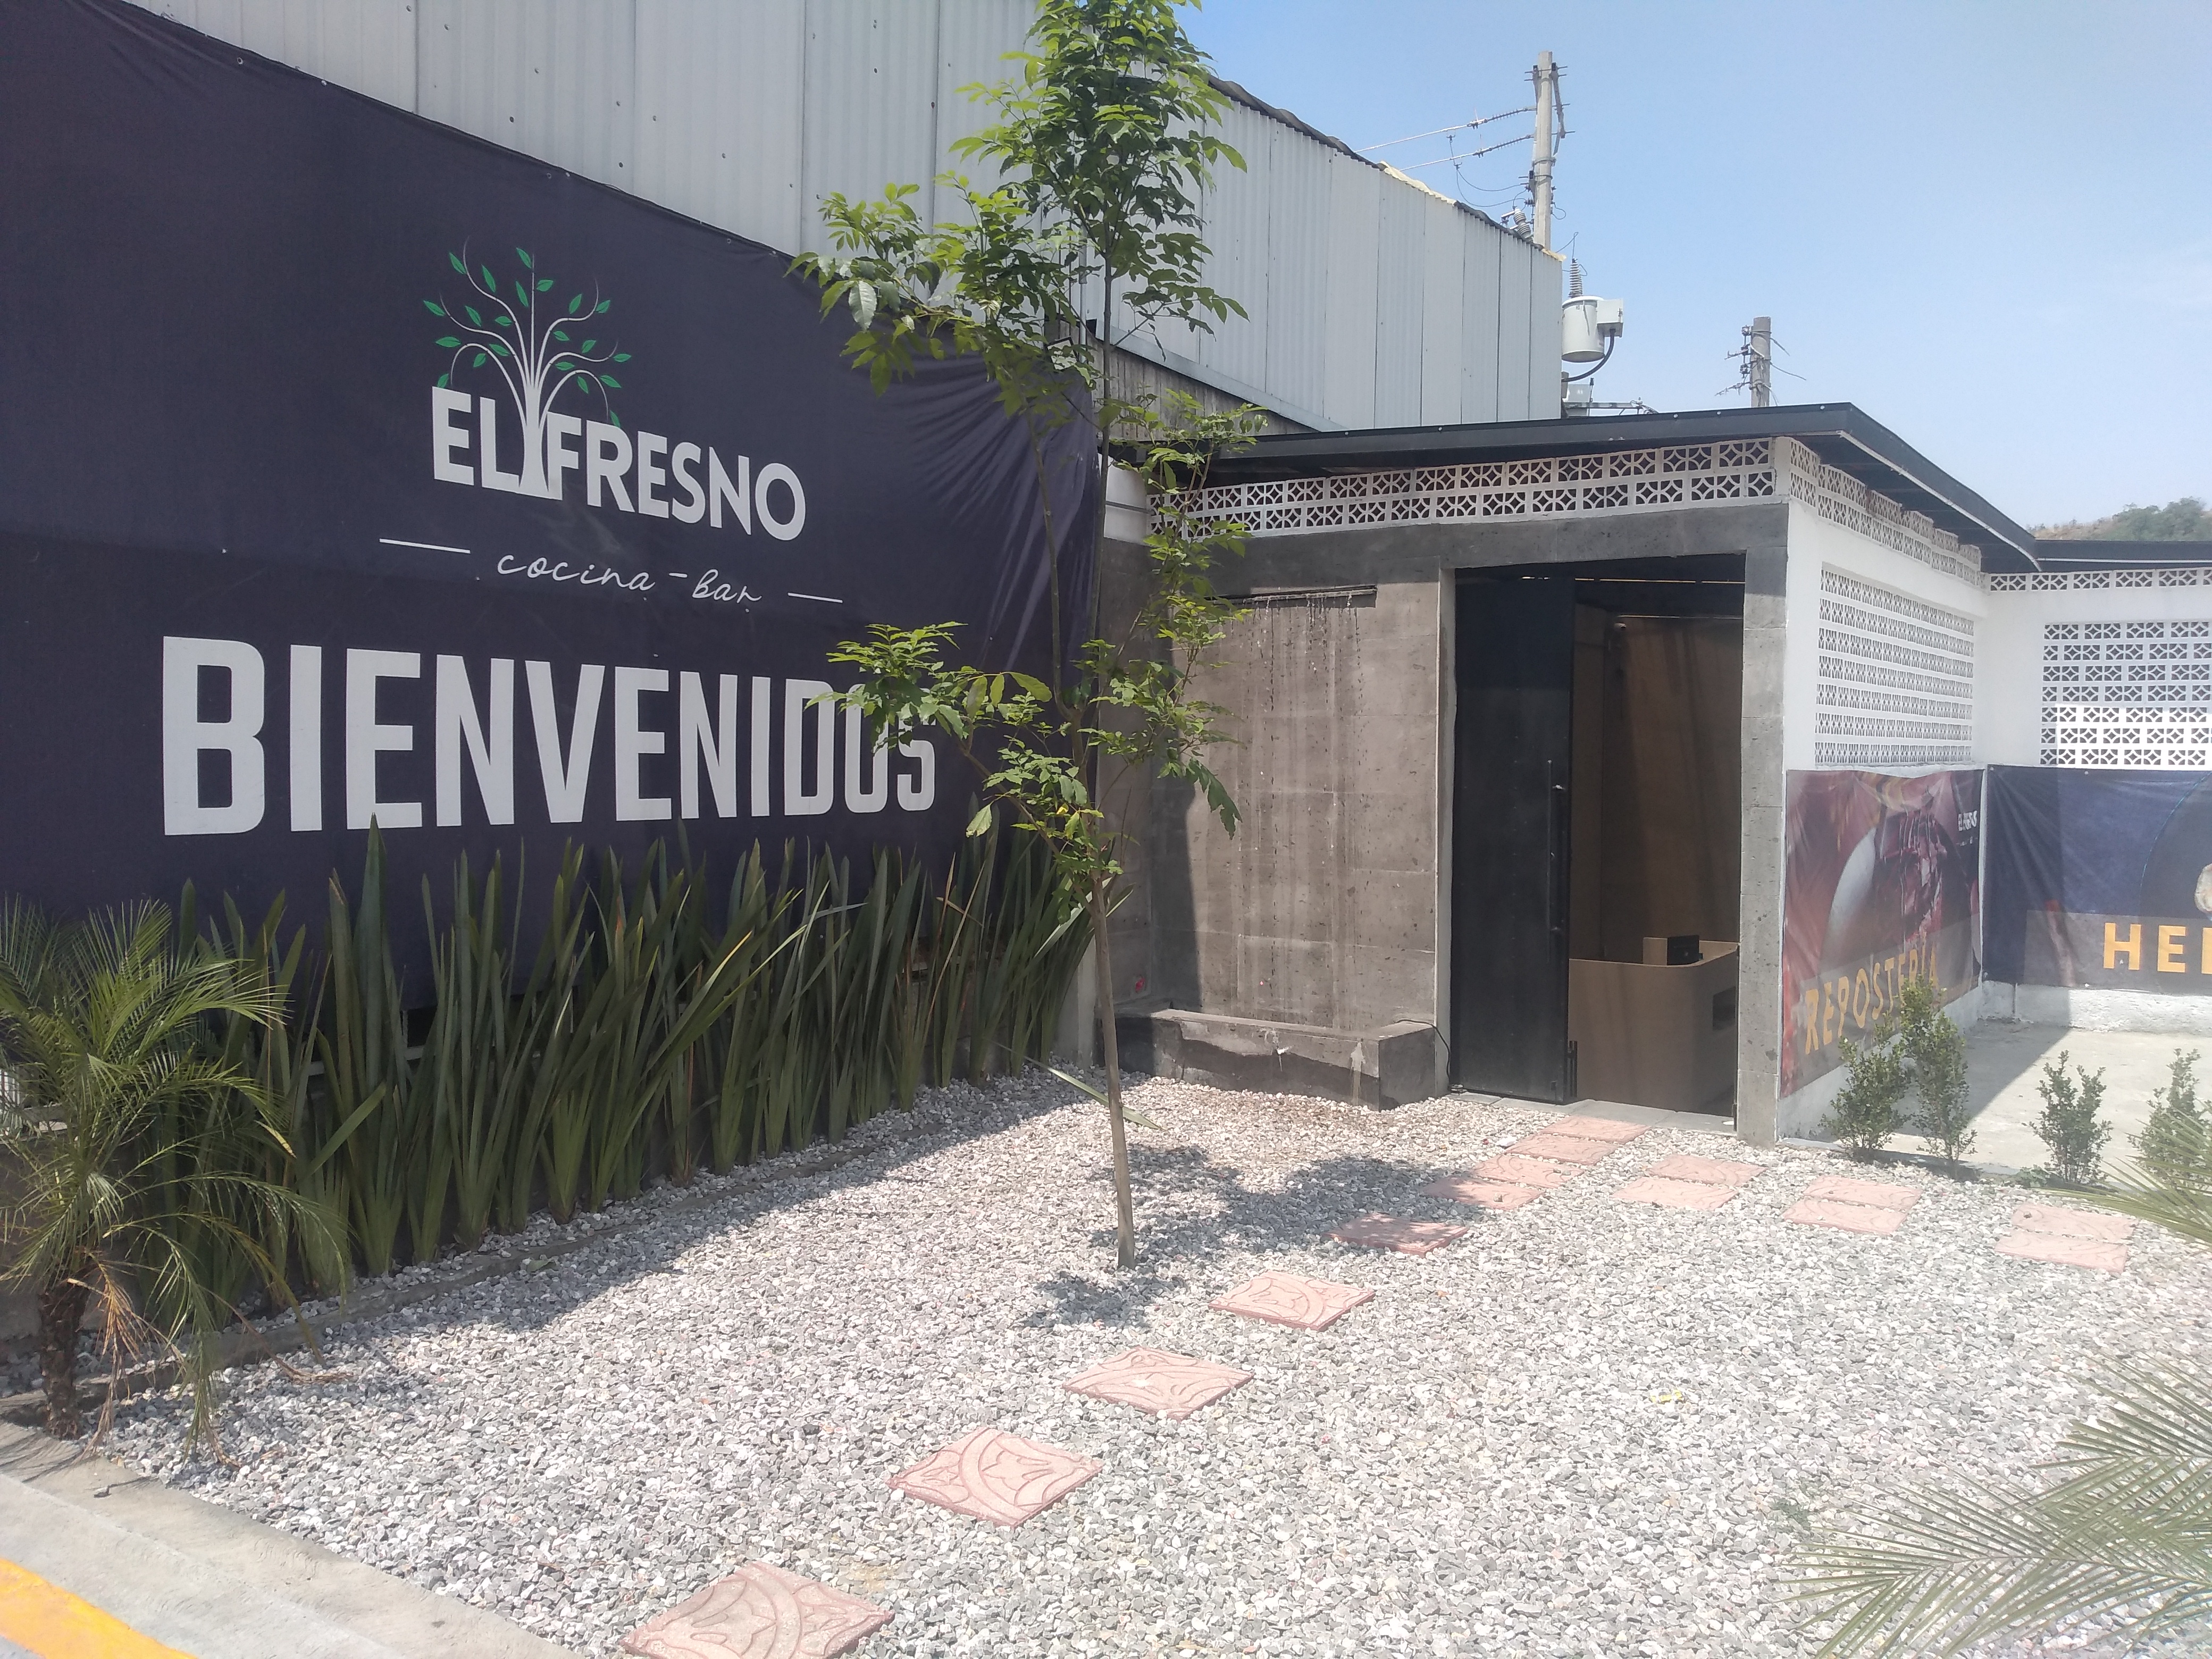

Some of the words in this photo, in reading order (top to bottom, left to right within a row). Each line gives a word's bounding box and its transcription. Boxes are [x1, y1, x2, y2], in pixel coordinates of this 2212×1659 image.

[432, 386, 520, 495] EL
[546, 410, 807, 542] FRESNO
[497, 555, 655, 591] cocina
[692, 569, 761, 604] bar
[163, 636, 936, 836] BIENVENIDOS
